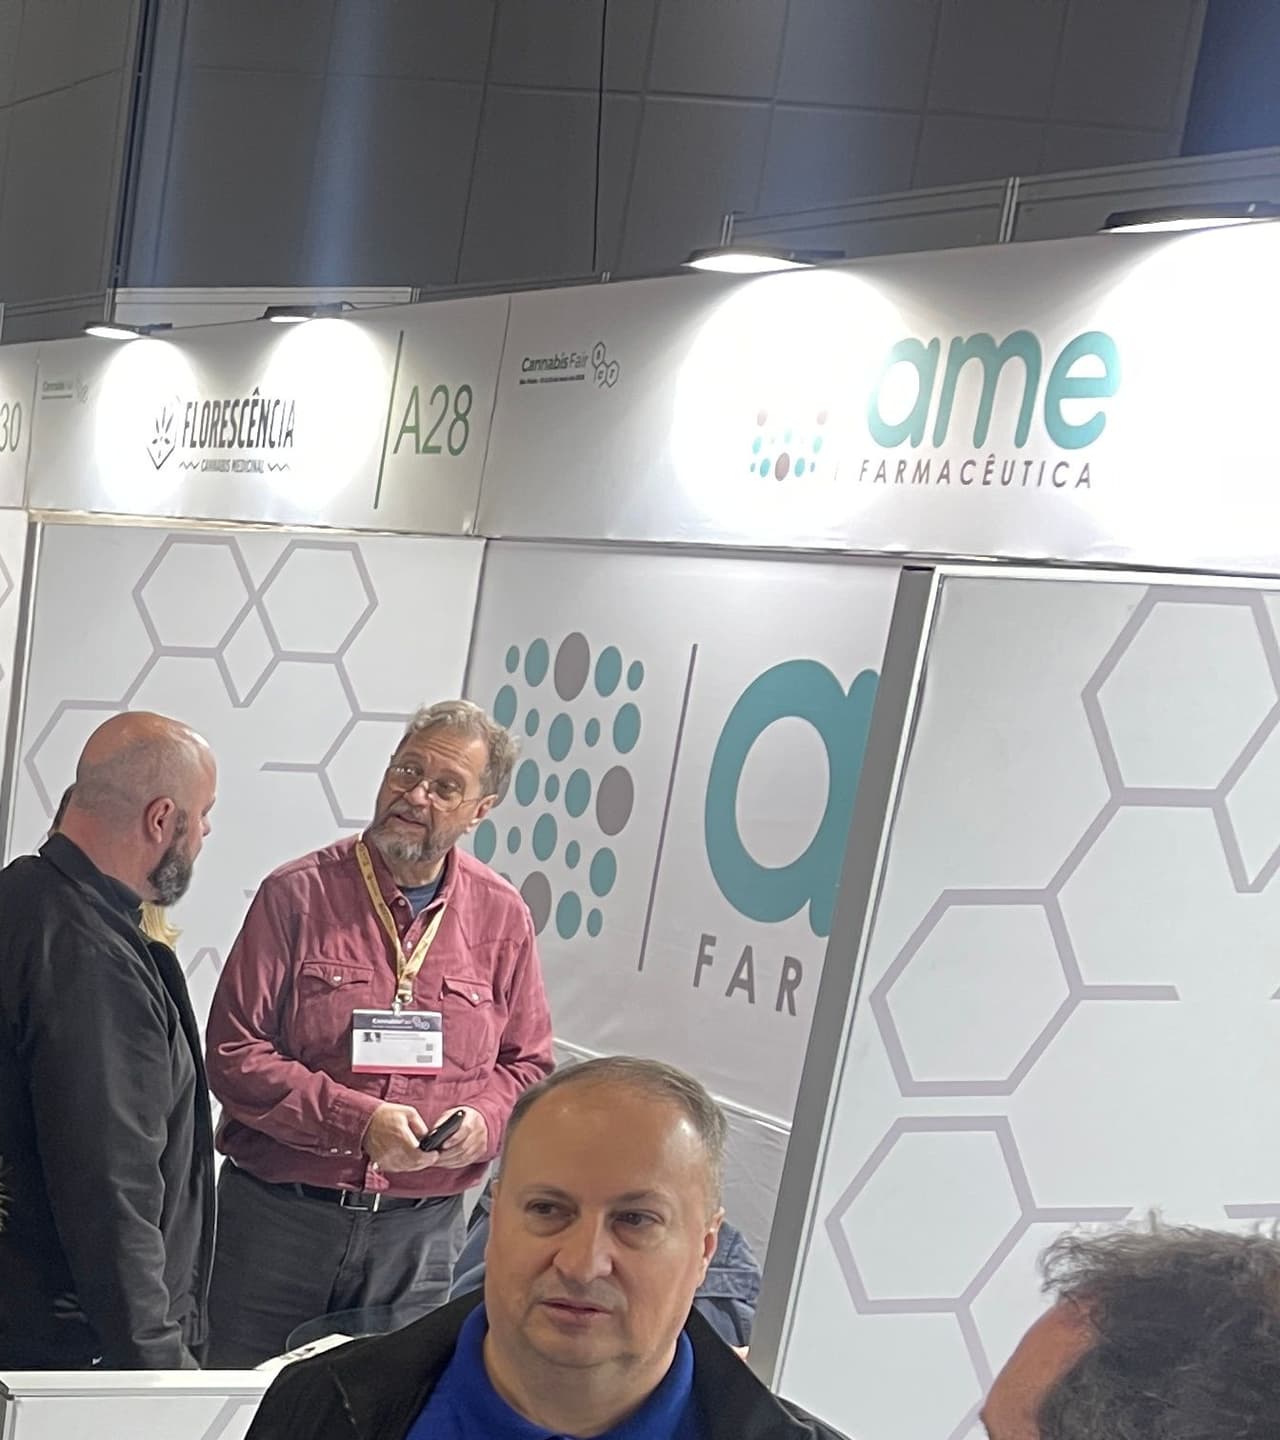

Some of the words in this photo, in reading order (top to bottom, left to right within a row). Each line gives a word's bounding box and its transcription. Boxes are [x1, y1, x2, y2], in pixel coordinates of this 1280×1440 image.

[182, 386, 296, 449] FLORESCÊNCIA
[393, 384, 473, 456] A28
[867, 330, 1122, 450] ame
[858, 455, 1093, 489] FARMACÊUTICA
